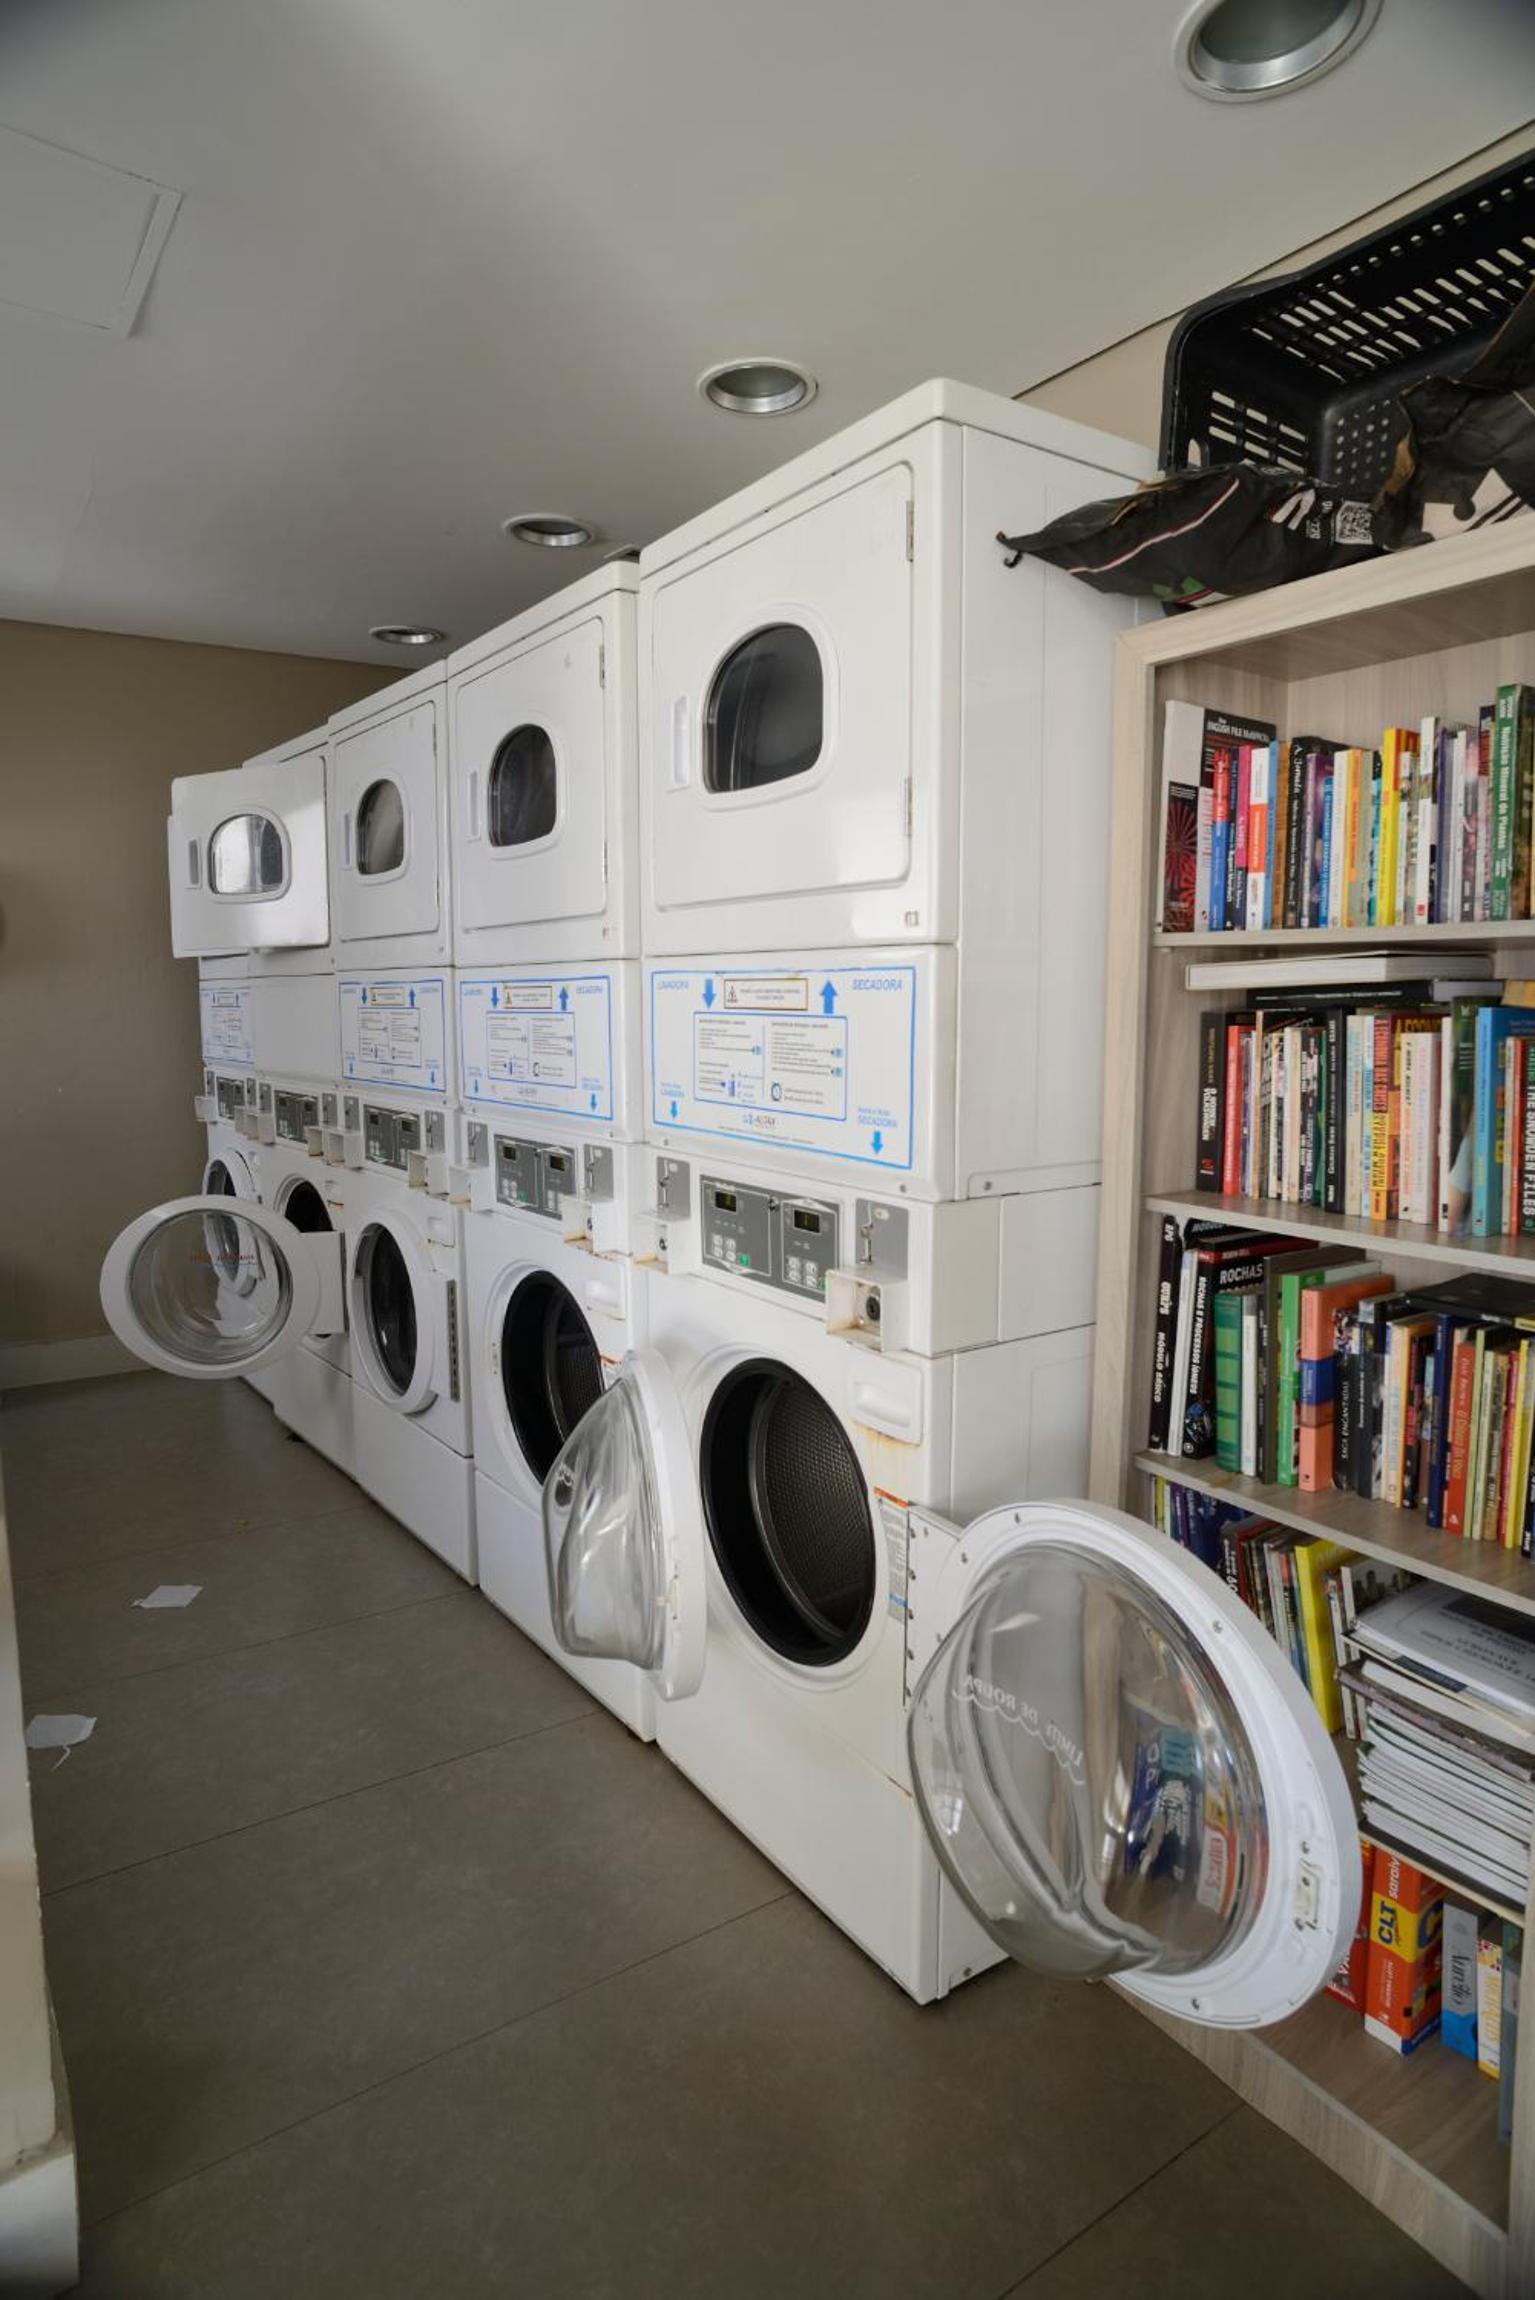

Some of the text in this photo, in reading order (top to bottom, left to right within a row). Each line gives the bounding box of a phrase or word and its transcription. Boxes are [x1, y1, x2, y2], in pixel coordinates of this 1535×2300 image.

[1500, 766, 1509, 800] Mineral
[1497, 815, 1507, 849] Plantas
[852, 978, 903, 991] SECADORA
[1202, 1088, 1210, 1141] VOLKSWAGEN
[1522, 1084, 1534, 1215] THE SNOWDEN FILES
[1219, 1263, 1264, 1284] ROCHAS
[1198, 1276, 1207, 1309] ROCHAS
[1155, 1331, 1167, 1370] MÓDULO
[1192, 1317, 1203, 1364] PROCESSOS
[1190, 1364, 1202, 1395] ÍGNEOS
[1388, 1853, 1400, 1900] saraiv
[1377, 1900, 1393, 1945] CLT
